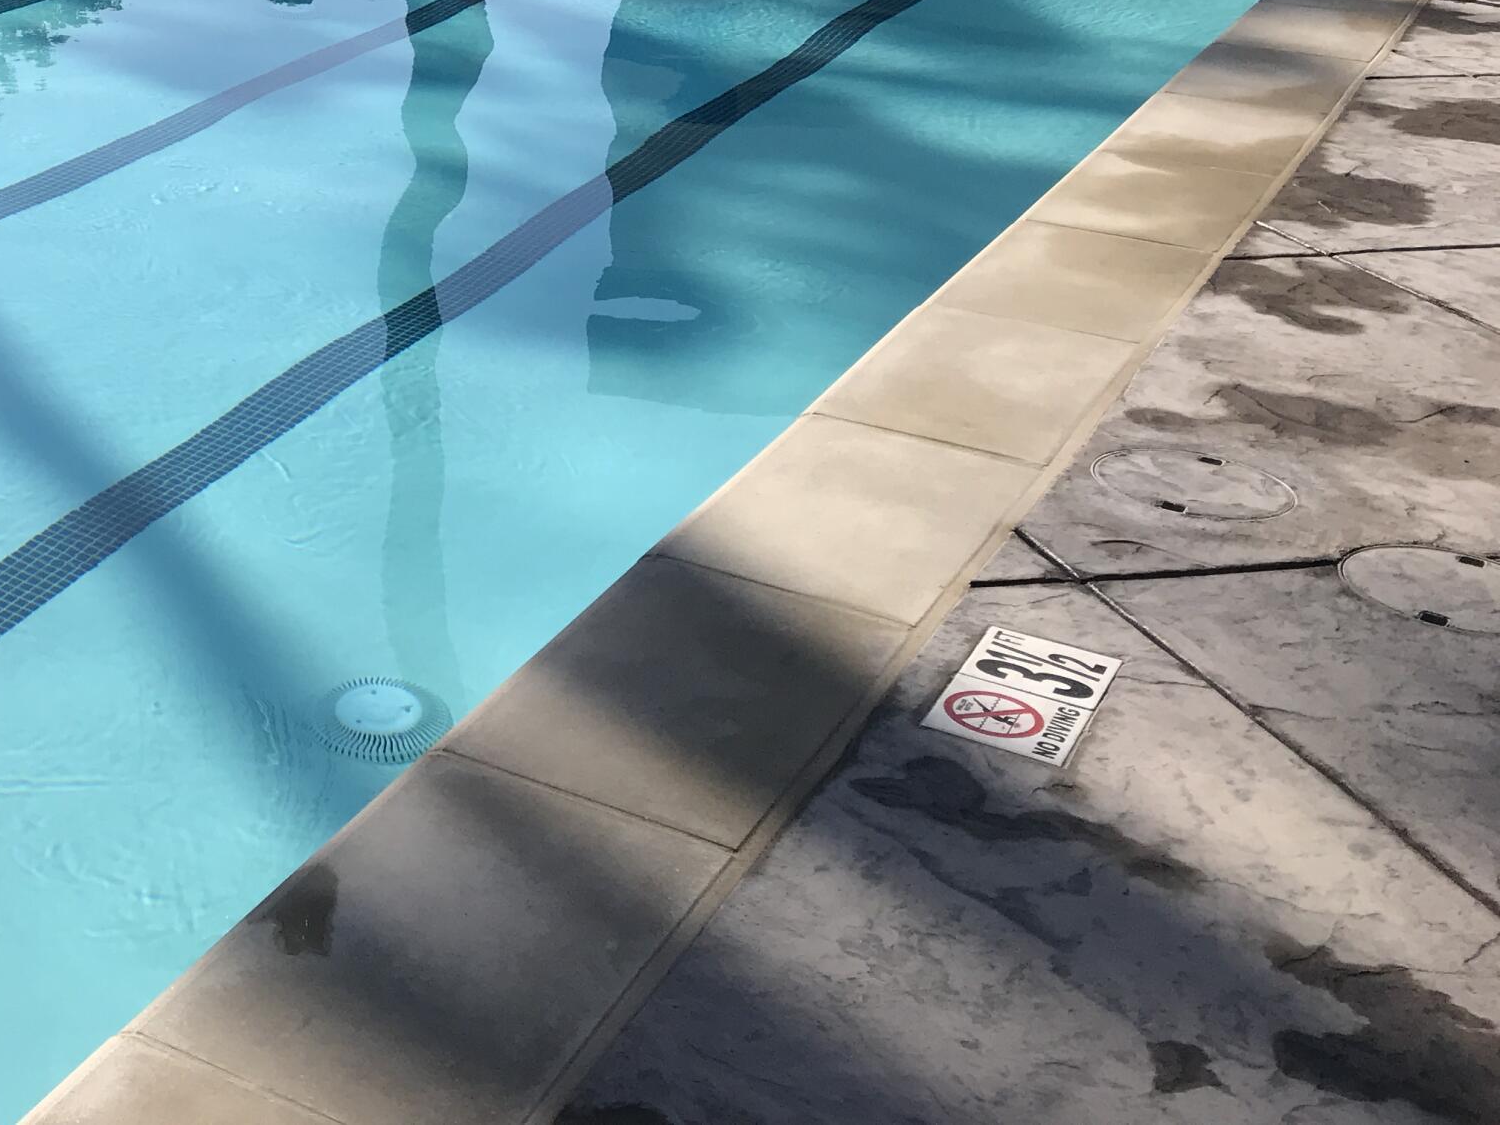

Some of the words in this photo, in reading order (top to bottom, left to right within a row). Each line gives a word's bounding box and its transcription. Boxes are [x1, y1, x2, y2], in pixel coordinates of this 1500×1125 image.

[993, 630, 1026, 646] FT
[1044, 705, 1081, 744] DIVING
[1032, 740, 1059, 759] NO
